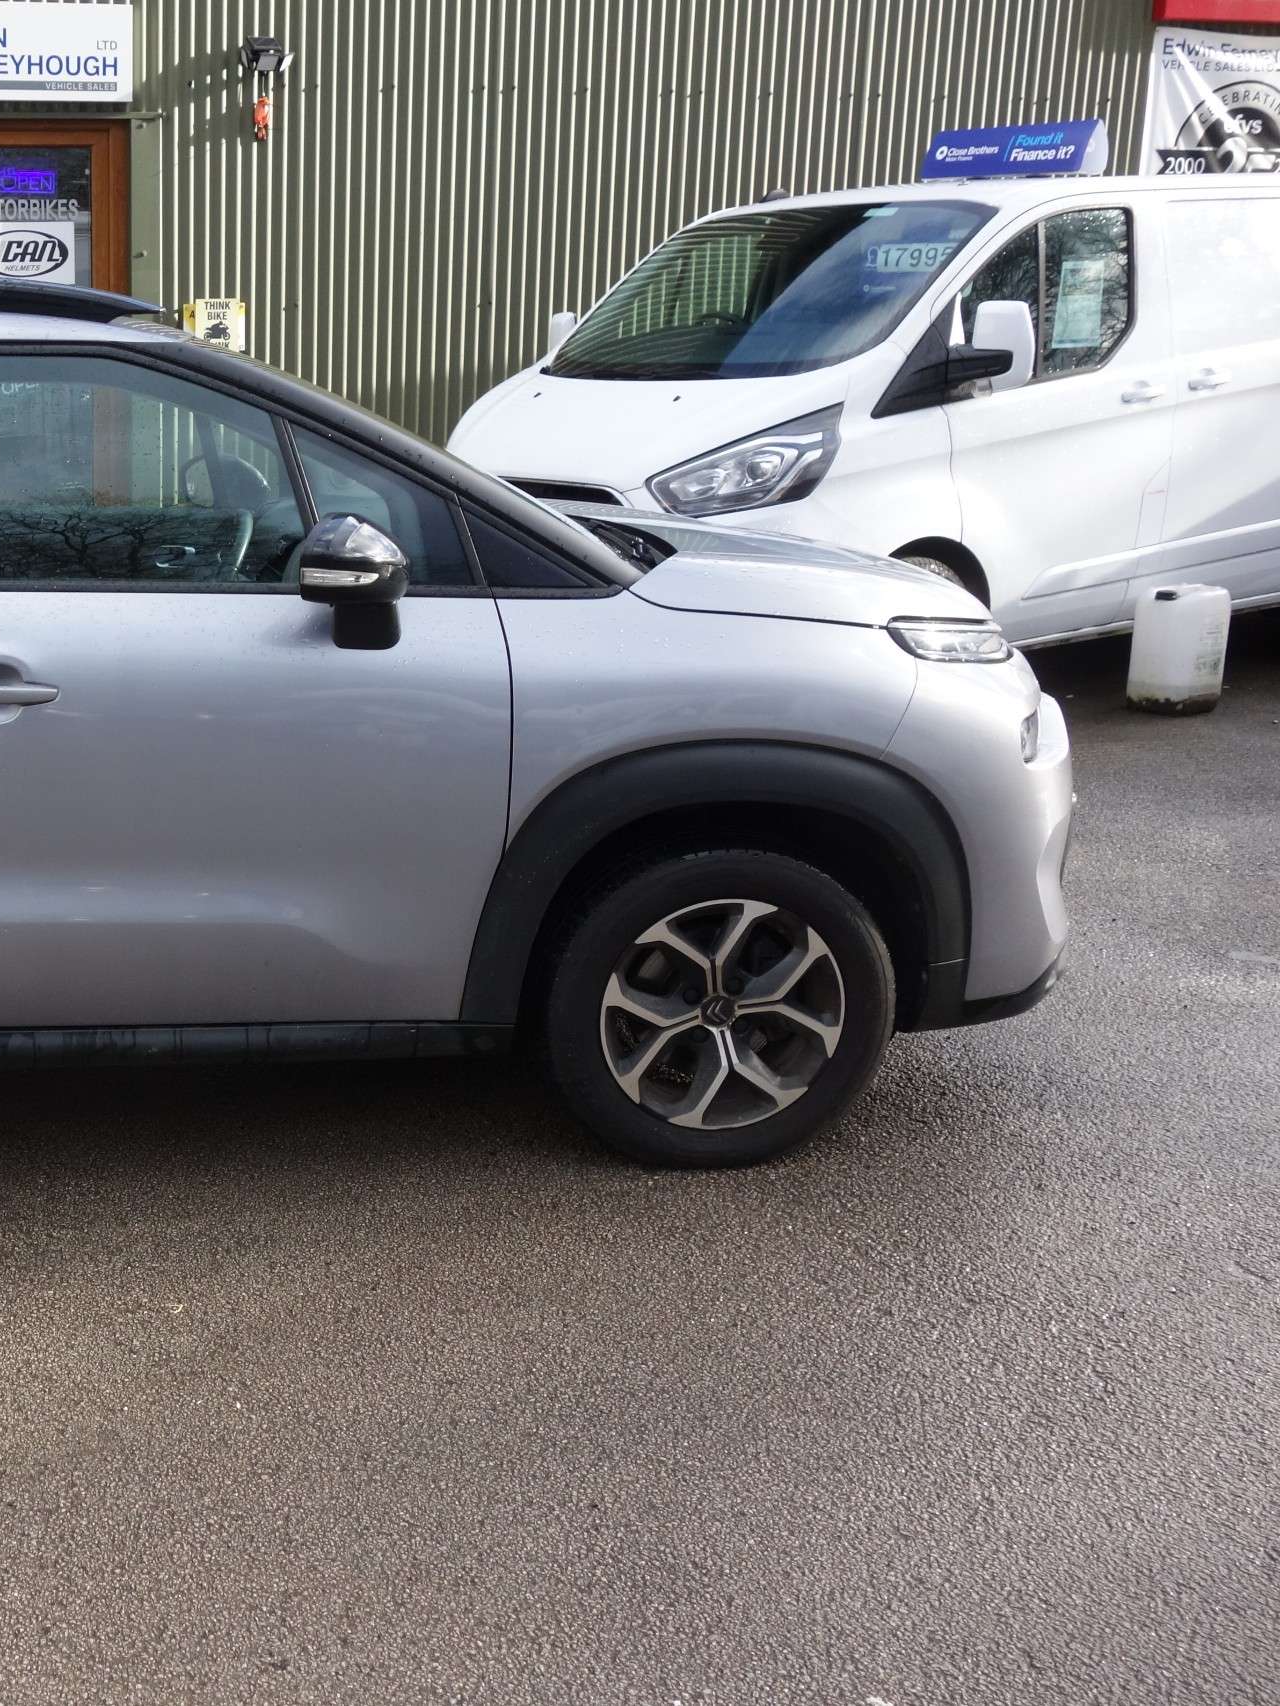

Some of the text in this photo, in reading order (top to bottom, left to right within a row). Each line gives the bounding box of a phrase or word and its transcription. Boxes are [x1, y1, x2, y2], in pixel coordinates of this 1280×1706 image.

[96, 40, 117, 50] LTD
[45, 82, 116, 91] VEHICLE SALES
[1016, 133, 1054, 146] Found
[1010, 145, 1075, 161] Finance it?
[1165, 156, 1206, 174] 2000
[0, 175, 53, 191] OPEN
[204, 301, 231, 310] THINK
[208, 311, 227, 320] BIKE
